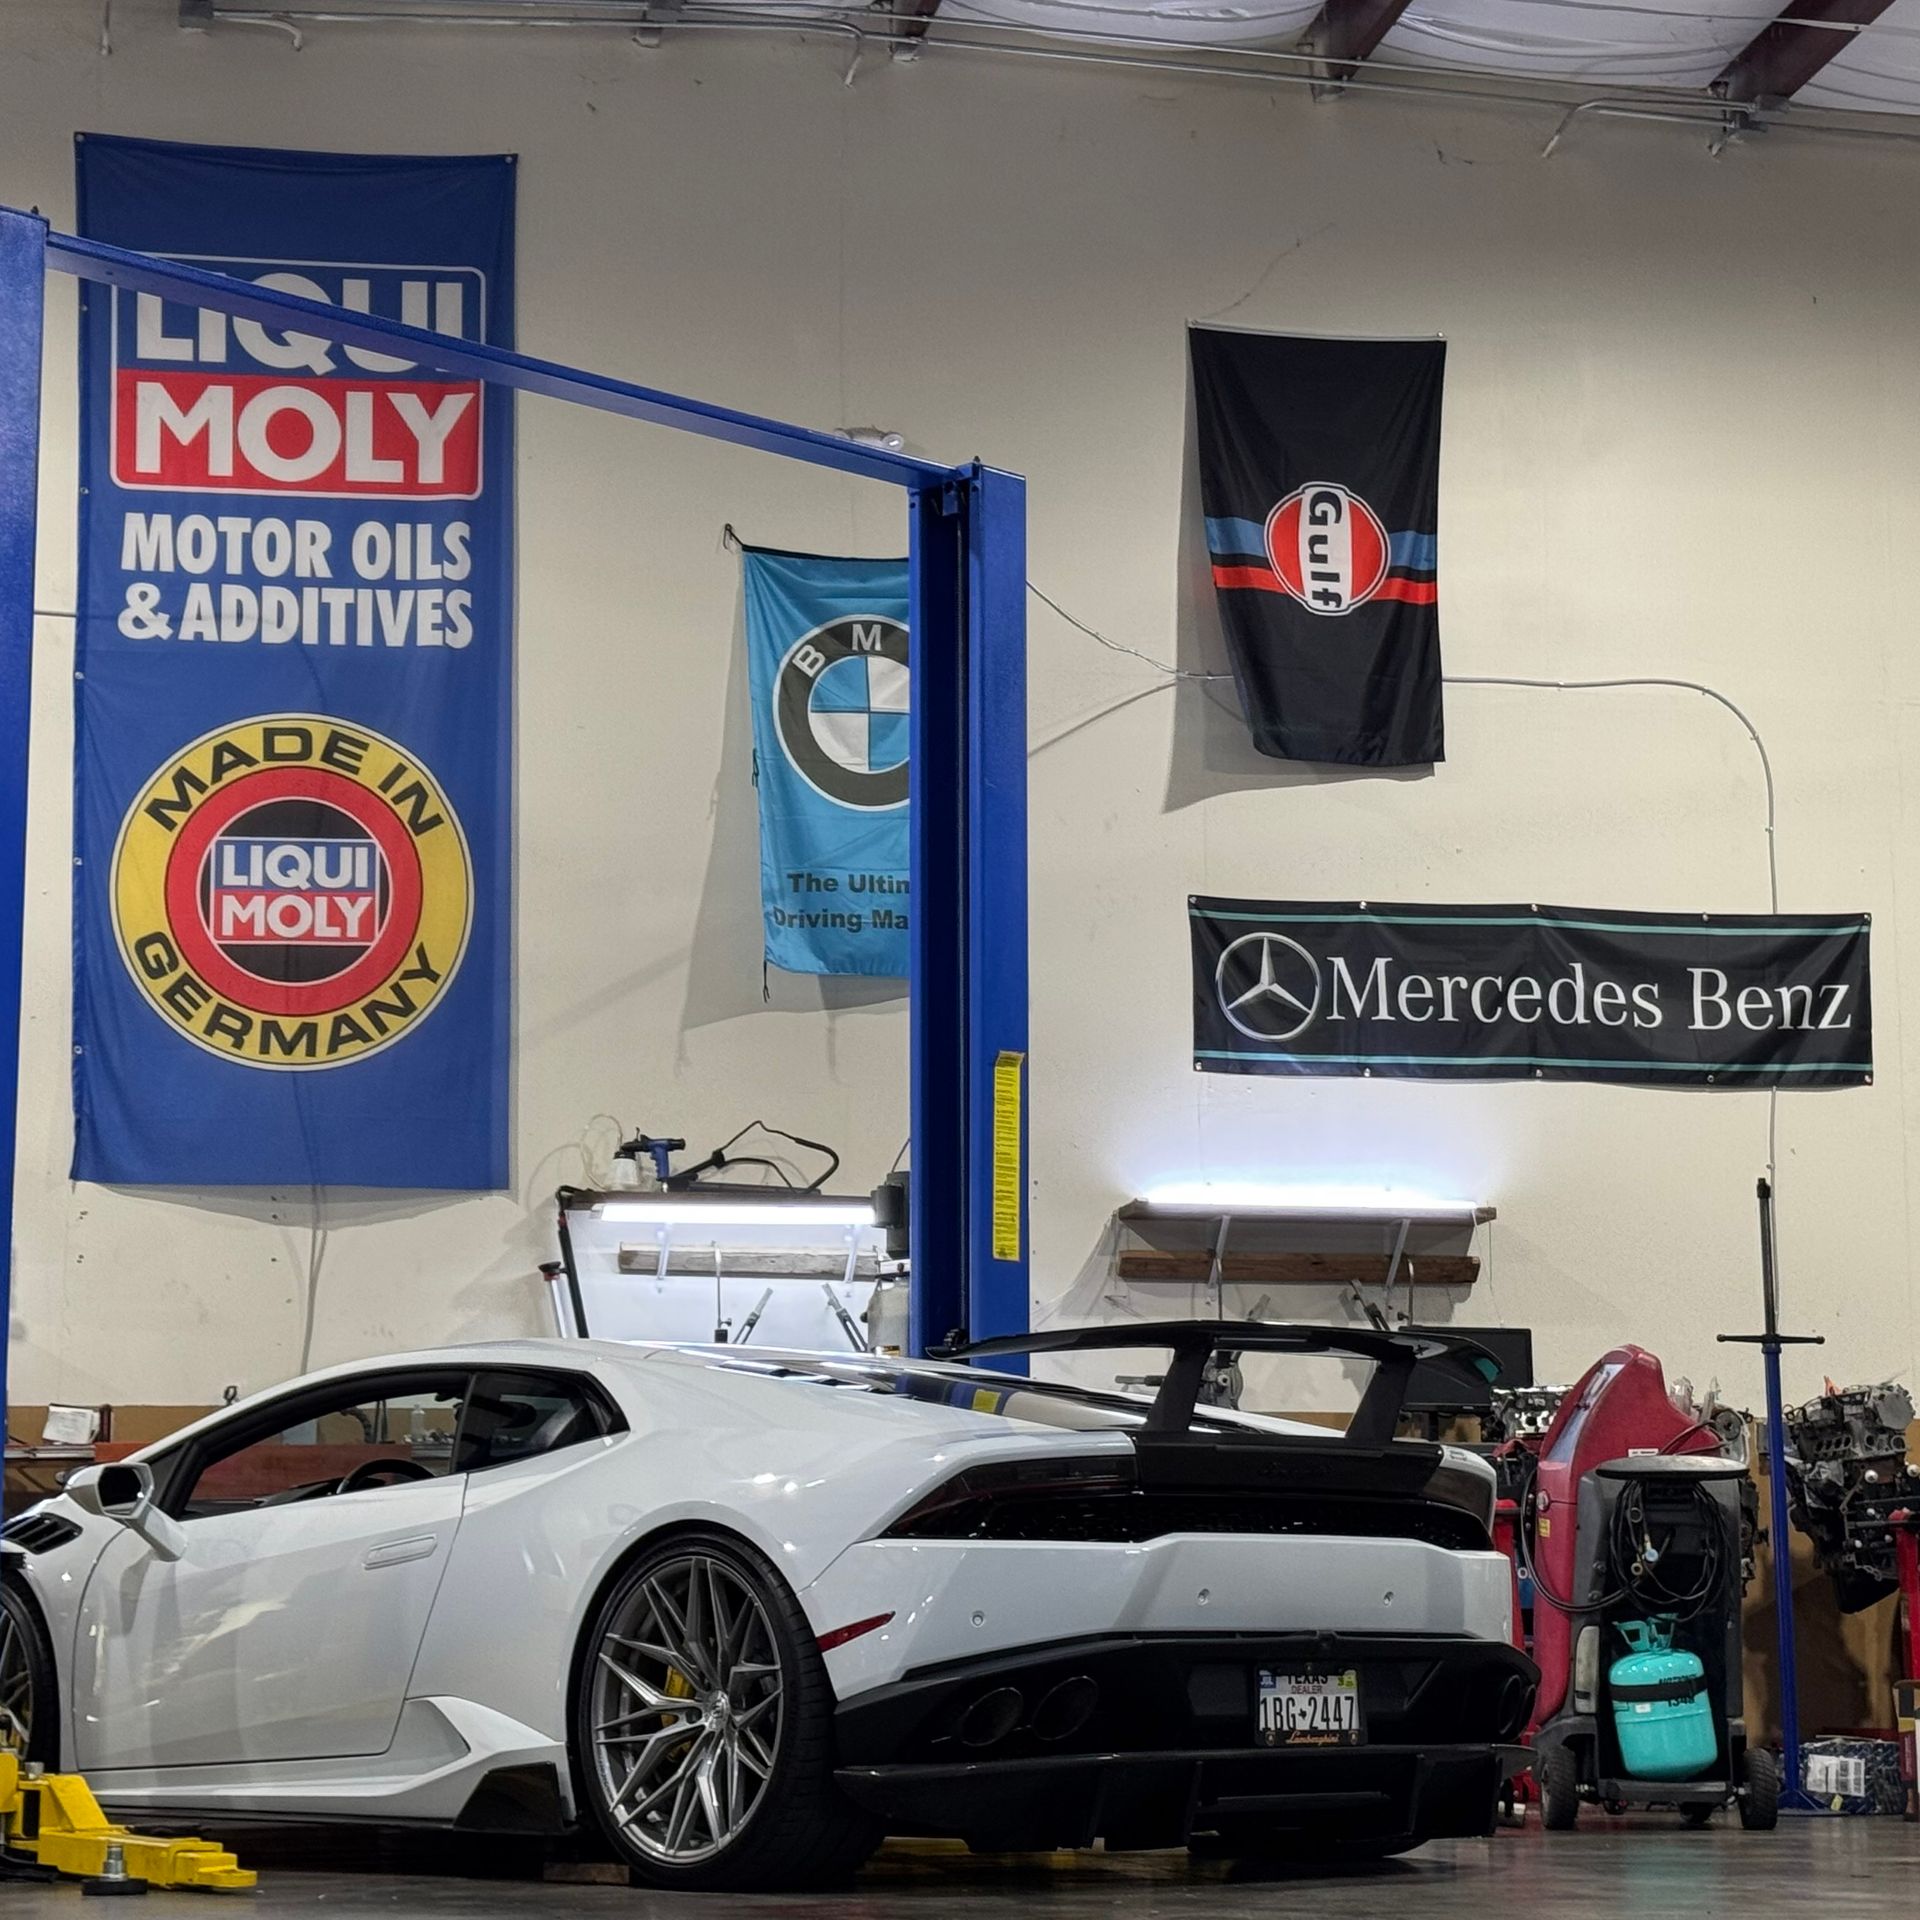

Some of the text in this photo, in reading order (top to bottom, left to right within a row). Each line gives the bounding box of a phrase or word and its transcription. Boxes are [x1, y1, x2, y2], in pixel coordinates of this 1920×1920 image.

[135, 381, 476, 484] MOLY
[120, 512, 472, 582] MOTOR OILS
[1308, 490, 1343, 608] Gulf
[117, 582, 474, 650] & ADDITIVES
[792, 623, 883, 678] BM
[143, 726, 446, 837] MADE IN
[221, 844, 369, 890] LIQUI
[786, 872, 839, 893] The
[221, 894, 373, 938] MOLY
[772, 905, 910, 934] Driving Ma
[133, 930, 442, 1058] GERMANY
[1326, 956, 1852, 1031] Mercedes Benz
